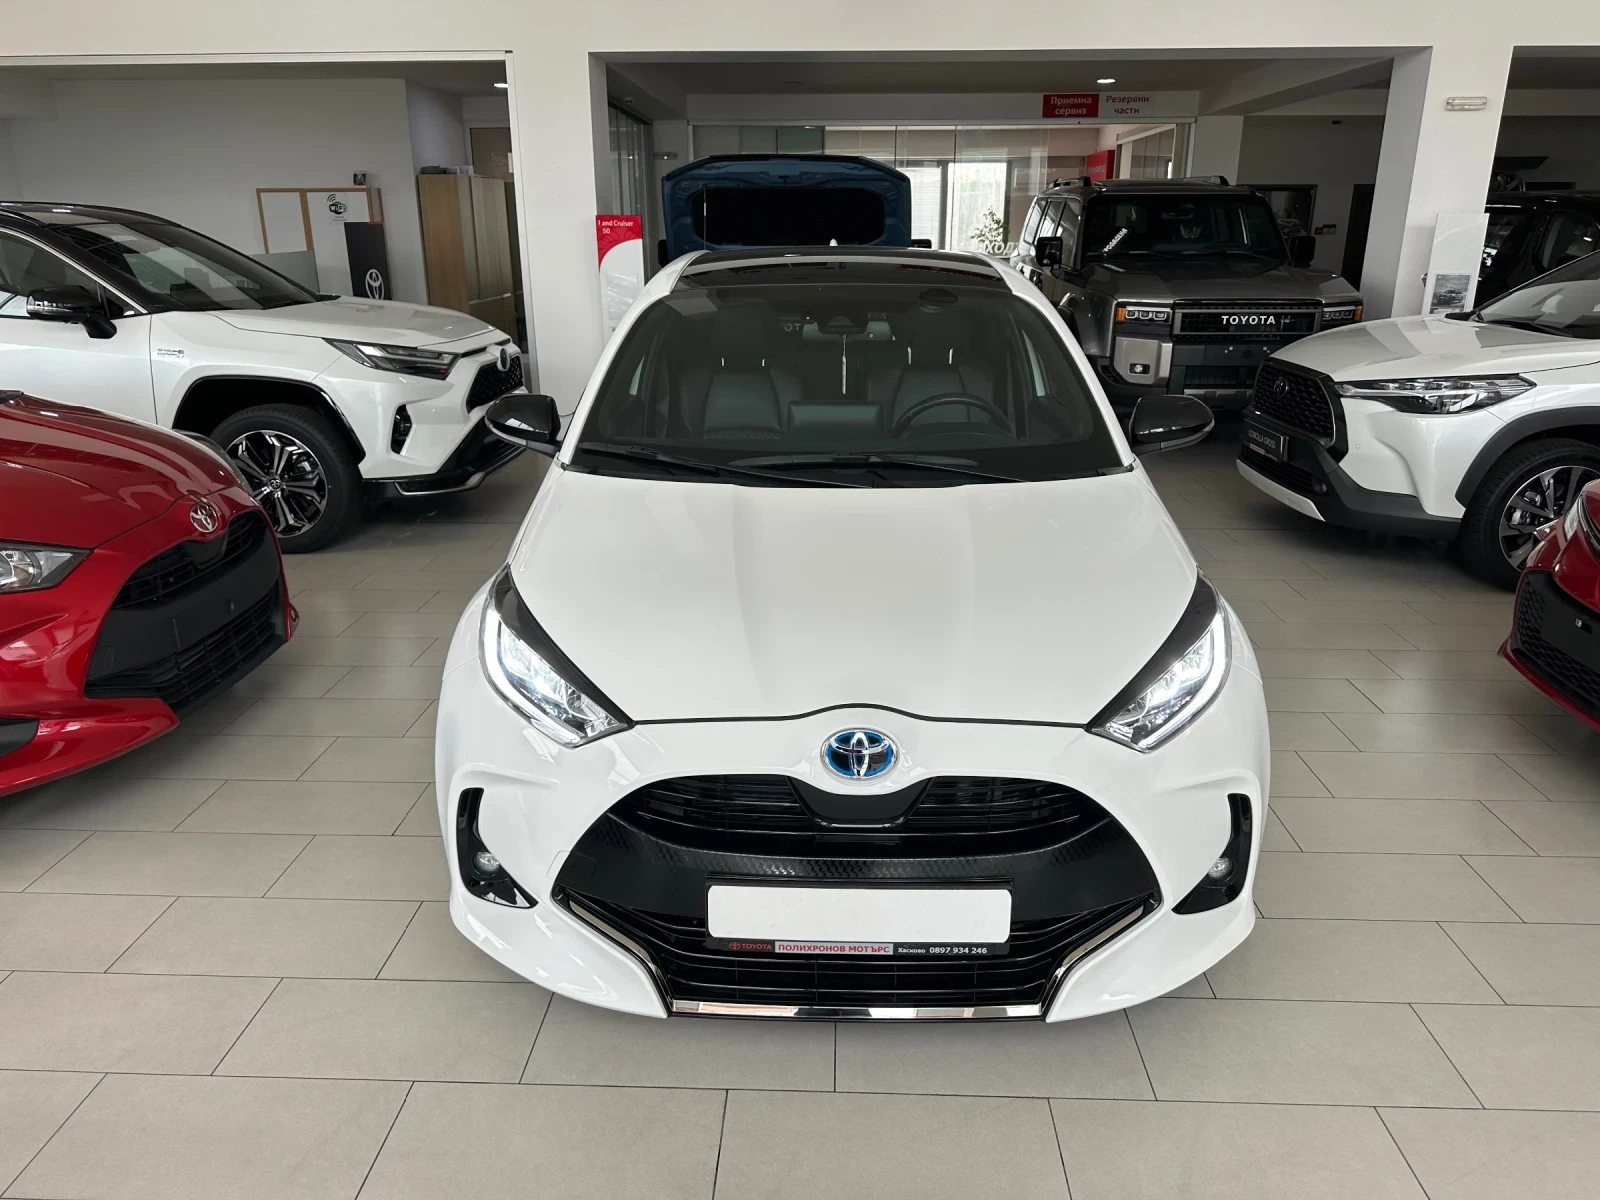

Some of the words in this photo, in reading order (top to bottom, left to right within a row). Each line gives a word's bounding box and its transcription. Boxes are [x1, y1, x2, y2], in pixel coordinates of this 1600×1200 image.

[1050, 96, 1092, 106] Приемна
[1106, 95, 1149, 104] Резервни
[1055, 107, 1086, 116] сервиз
[1114, 107, 1139, 115] части
[1101, 227, 1128, 253] РОДАДЕНА
[1221, 315, 1276, 325] TOYOTA
[778, 944, 846, 952] ПОЛИХРОНОВ
[849, 945, 890, 953] МОТЪРС
[929, 946, 951, 954] 0897
